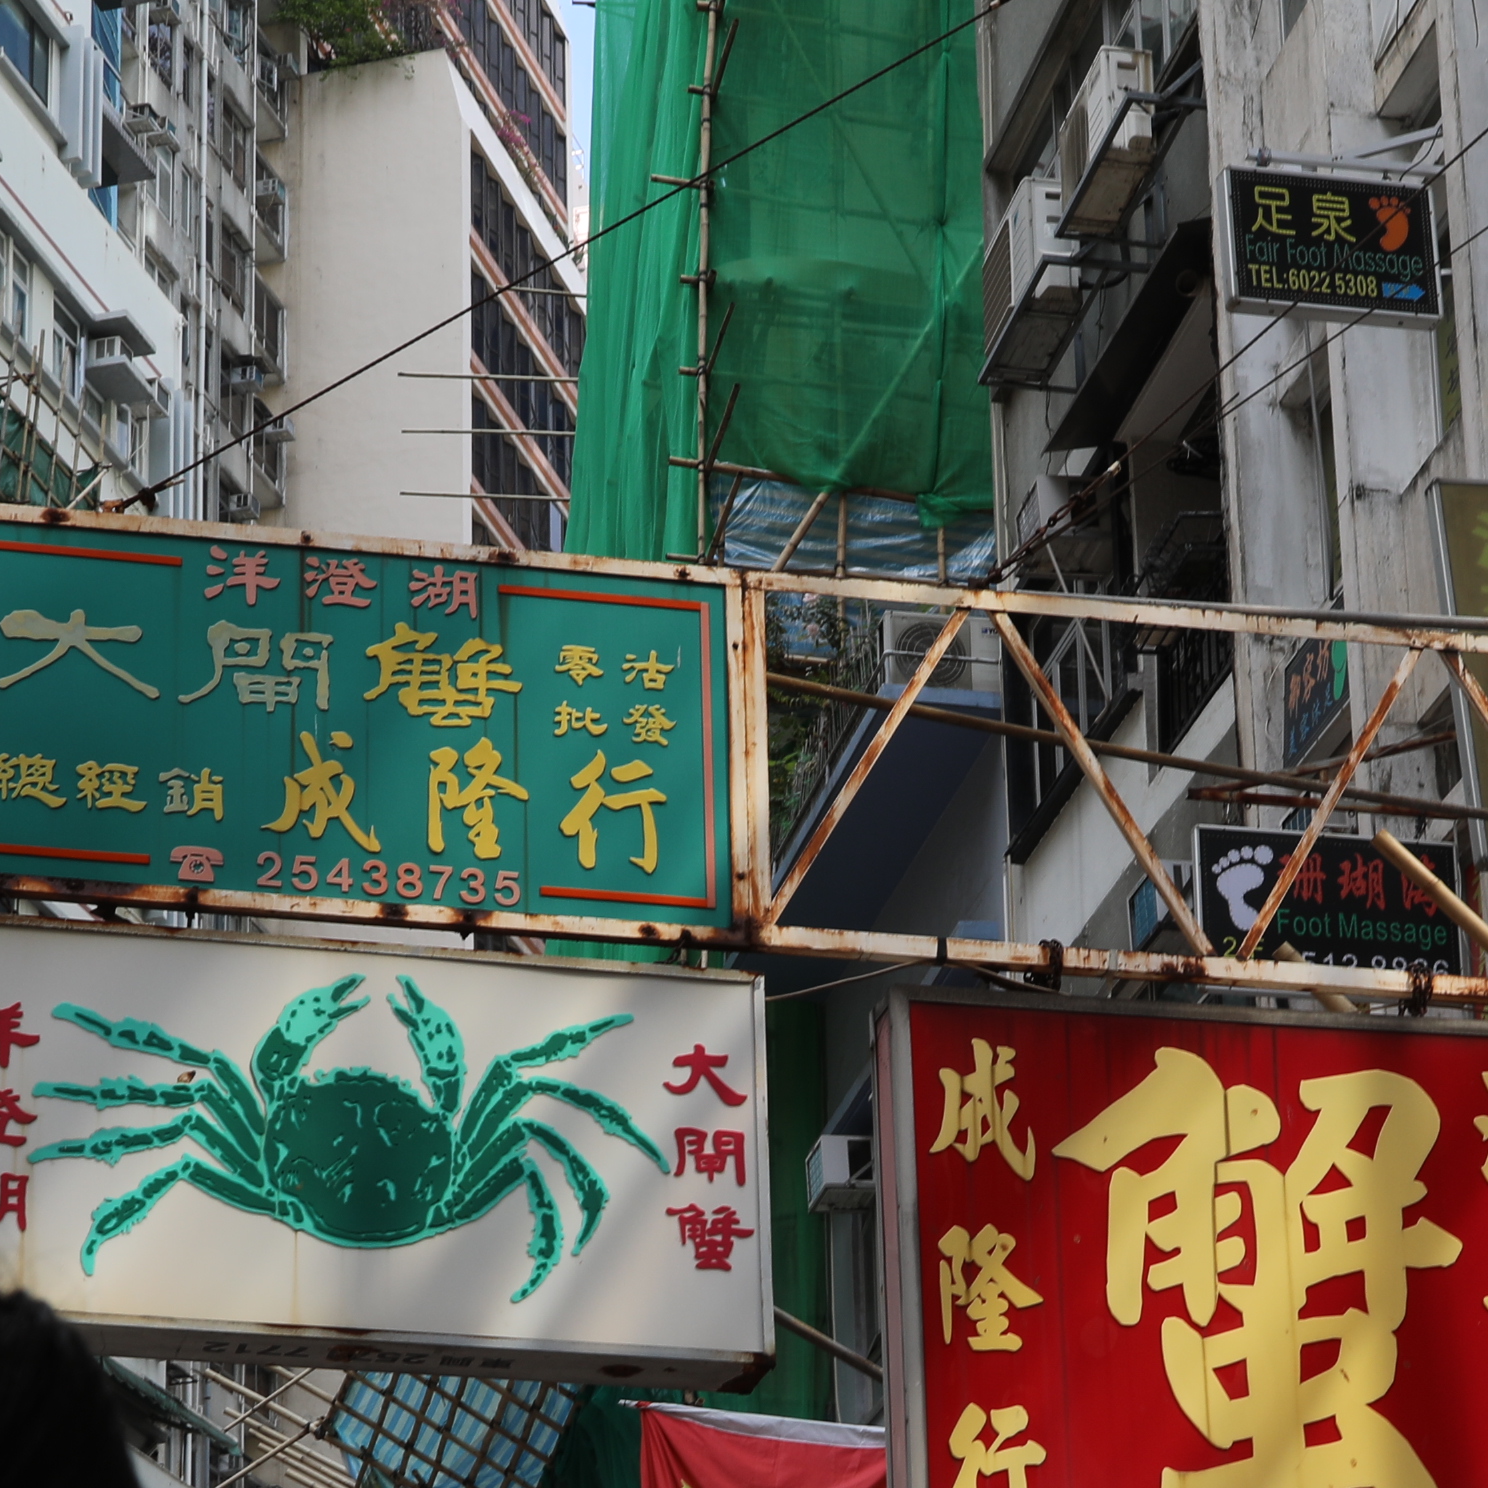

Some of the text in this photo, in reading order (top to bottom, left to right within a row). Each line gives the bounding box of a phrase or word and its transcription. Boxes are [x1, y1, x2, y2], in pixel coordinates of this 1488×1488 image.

[1251, 185, 1356, 242] 足泉
[1244, 233, 1424, 282] Fair Foot Massage
[1335, 273, 1378, 298] 5308
[203, 544, 480, 620] 洋澄湖
[553, 644, 675, 692] 零沽
[553, 703, 677, 748] 批發
[261, 730, 669, 875] 成隆行
[256, 850, 522, 908] 25438735
[1276, 908, 1448, 951] Foot Massage
[662, 1043, 754, 1273] 大閘蟹
